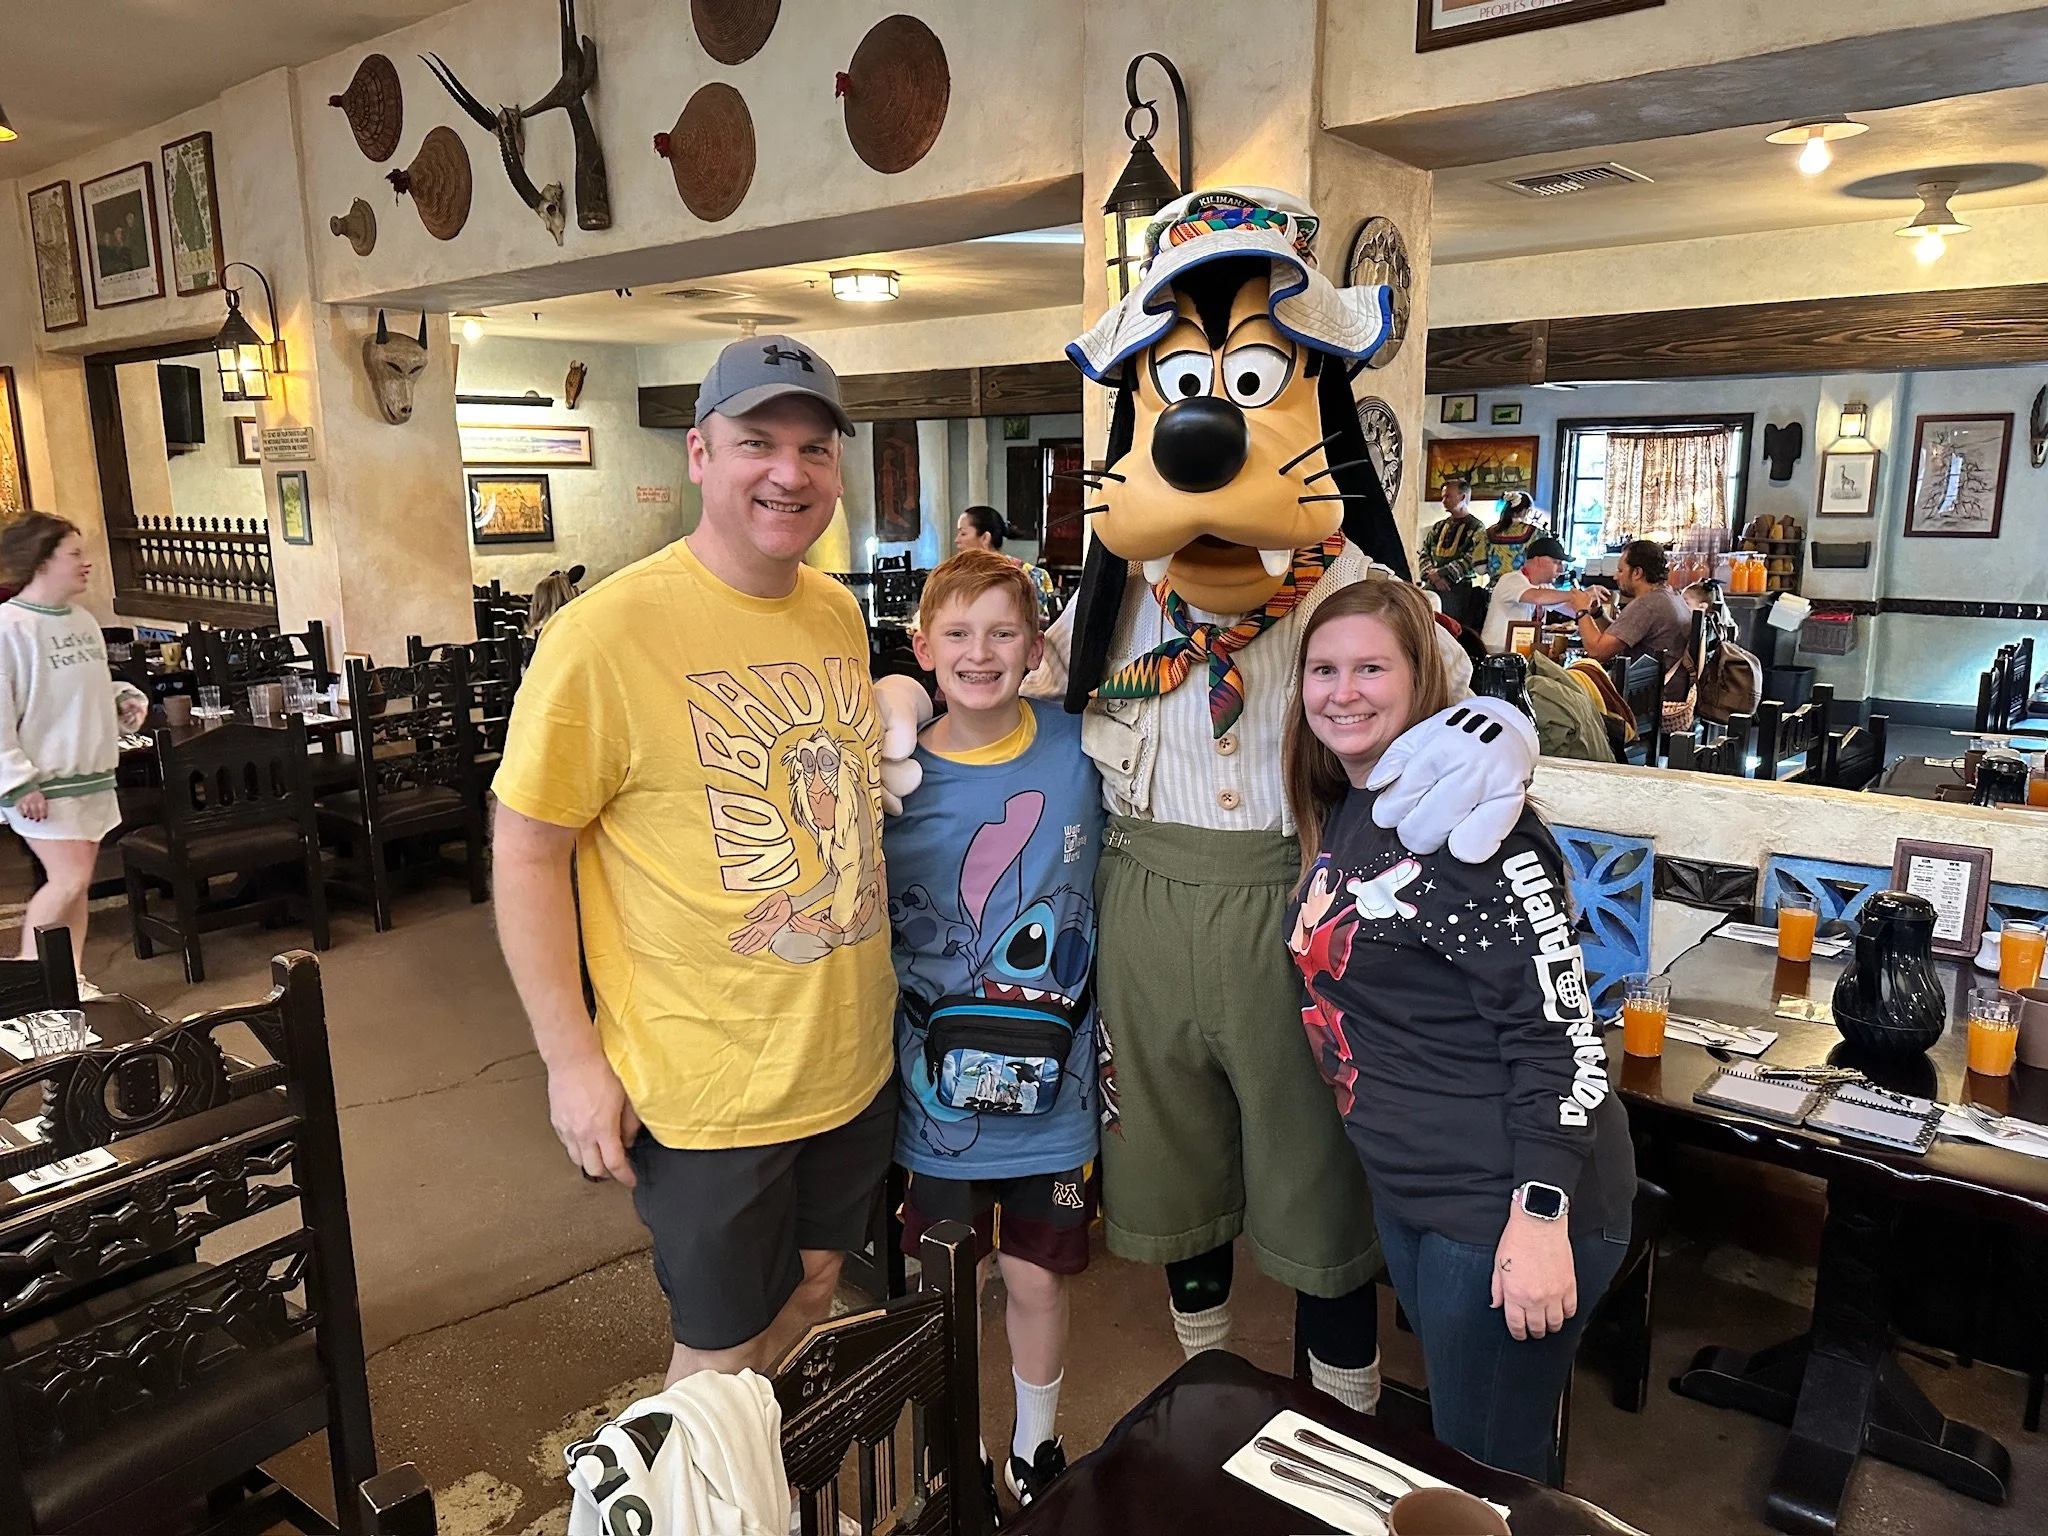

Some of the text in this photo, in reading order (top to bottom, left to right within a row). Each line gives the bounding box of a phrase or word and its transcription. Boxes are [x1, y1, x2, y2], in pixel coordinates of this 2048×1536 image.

[1479, 0, 1526, 19] PEOPLES
[48, 651, 76, 669] For
[686, 662, 826, 791] BAD
[704, 784, 801, 891] NO
[1052, 1181, 1084, 1209] M
